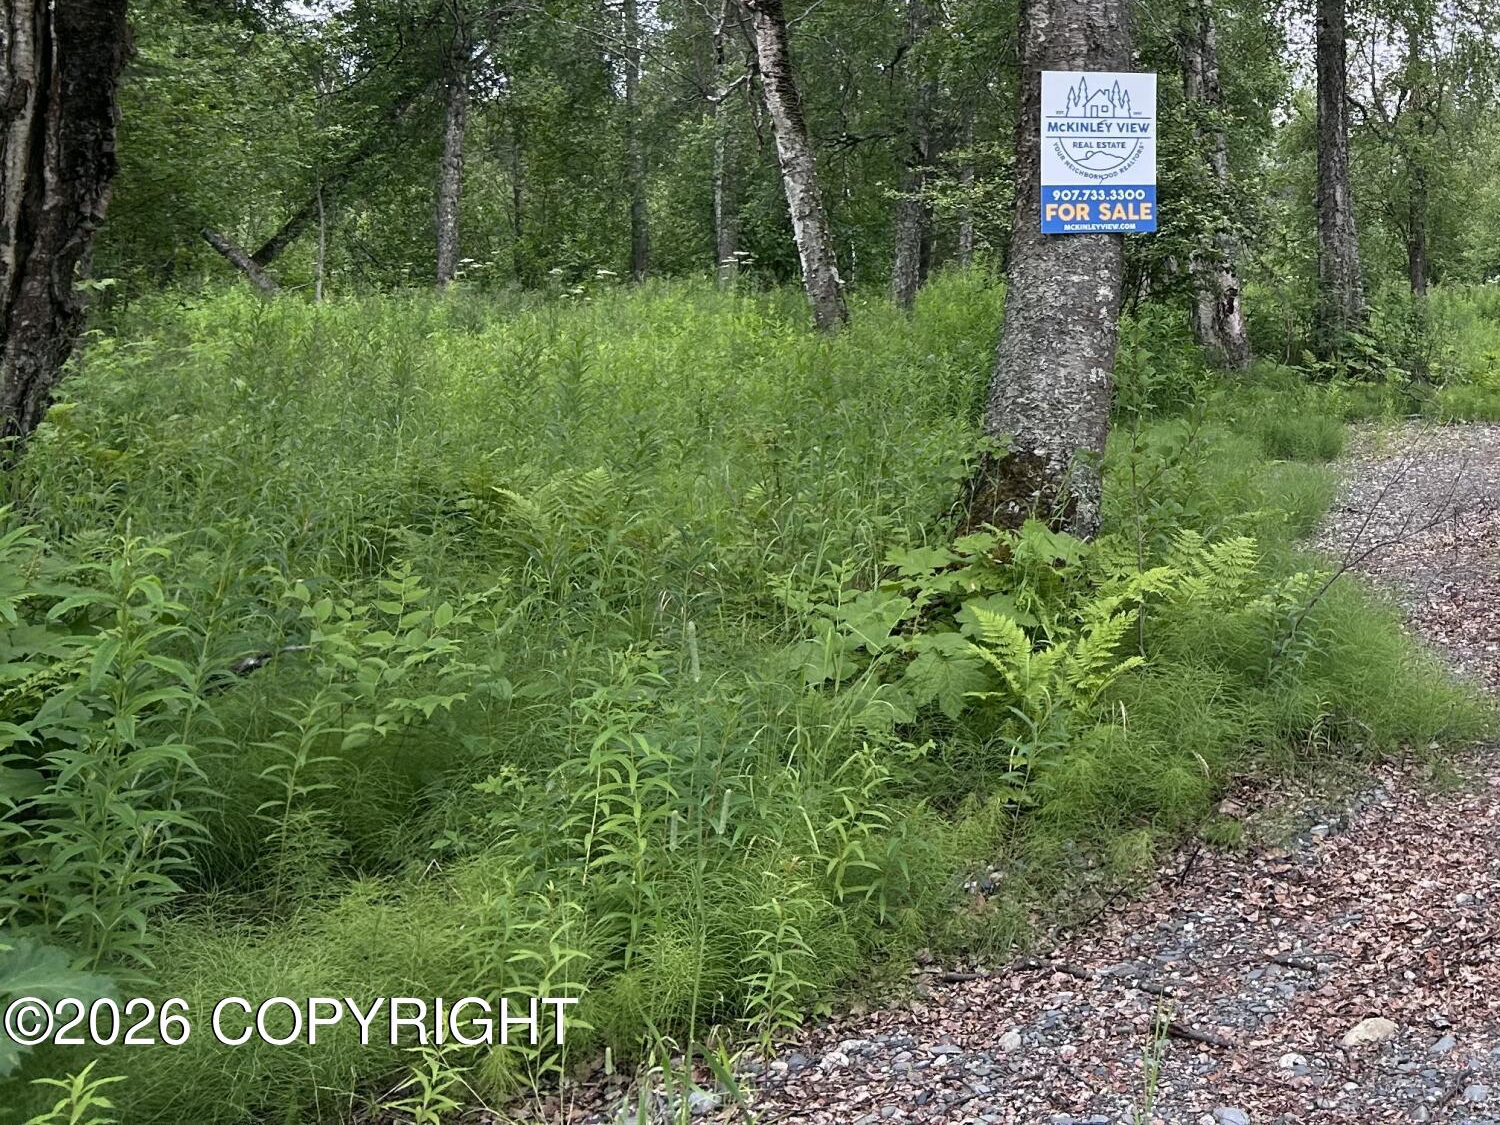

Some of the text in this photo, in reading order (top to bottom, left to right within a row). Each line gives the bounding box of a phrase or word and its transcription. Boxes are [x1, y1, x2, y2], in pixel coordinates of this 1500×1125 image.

[1047, 121, 1150, 133] McKINLEY VIEW
[1072, 141, 1126, 149] REAL ESTATE
[1052, 142, 1065, 162] YOUR
[1052, 189, 1146, 201] 907.733.3300
[1045, 202, 1153, 221] FOR SALE
[1063, 223, 1136, 231] MCKINLEYVIEW.COM
